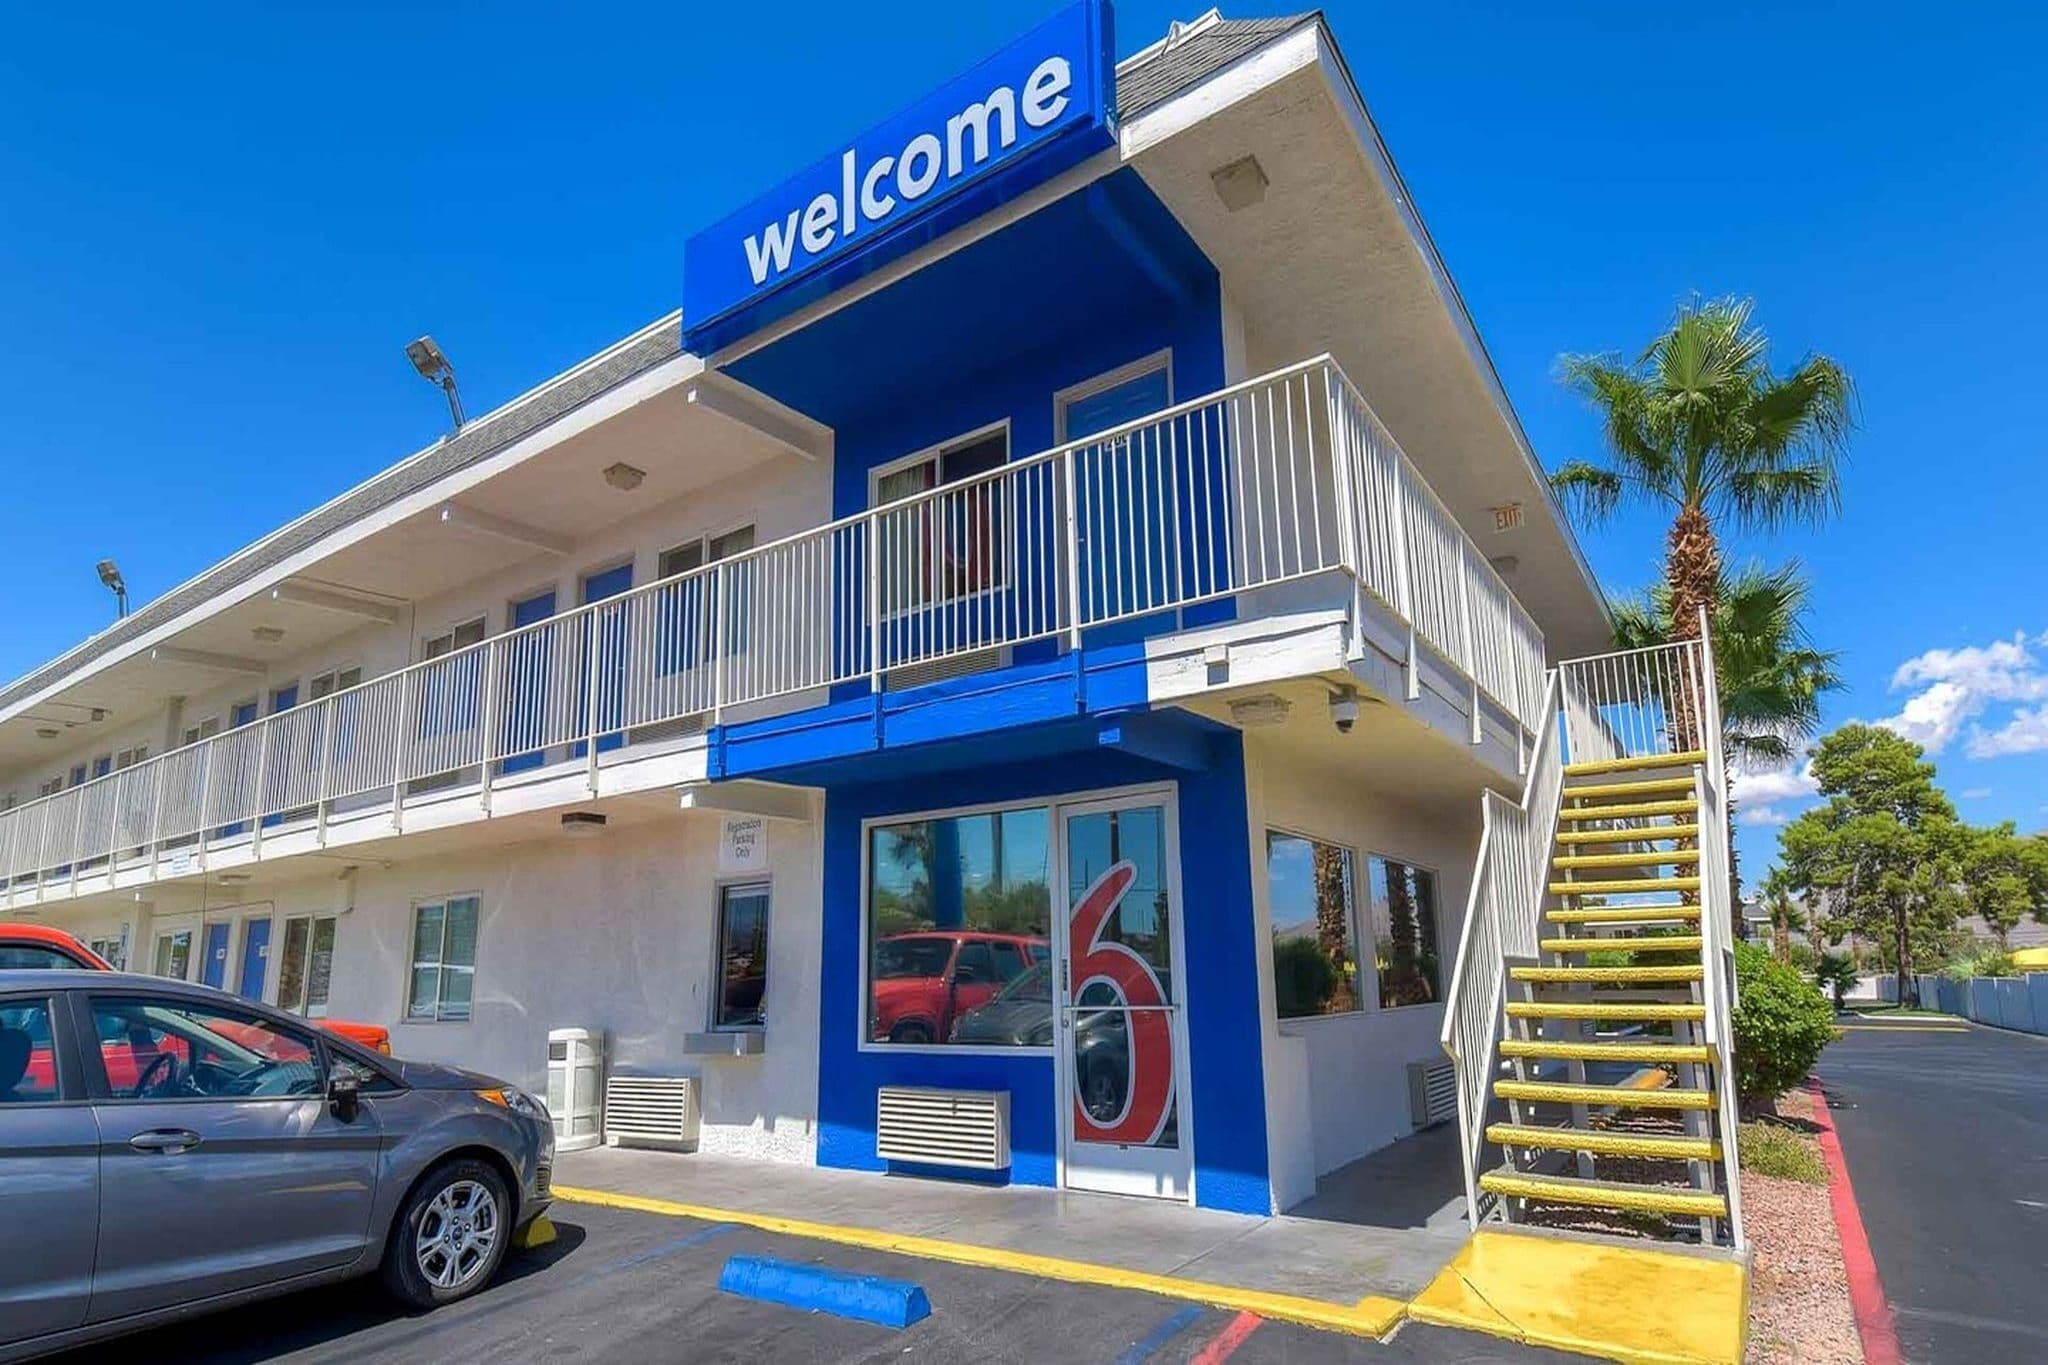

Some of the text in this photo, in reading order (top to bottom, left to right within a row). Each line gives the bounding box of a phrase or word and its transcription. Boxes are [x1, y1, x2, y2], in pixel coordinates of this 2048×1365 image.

[743, 56, 1072, 285] welcome
[1496, 507, 1521, 529] EXIT
[735, 846, 750, 858] Only
[1071, 859, 1175, 1144] 6
